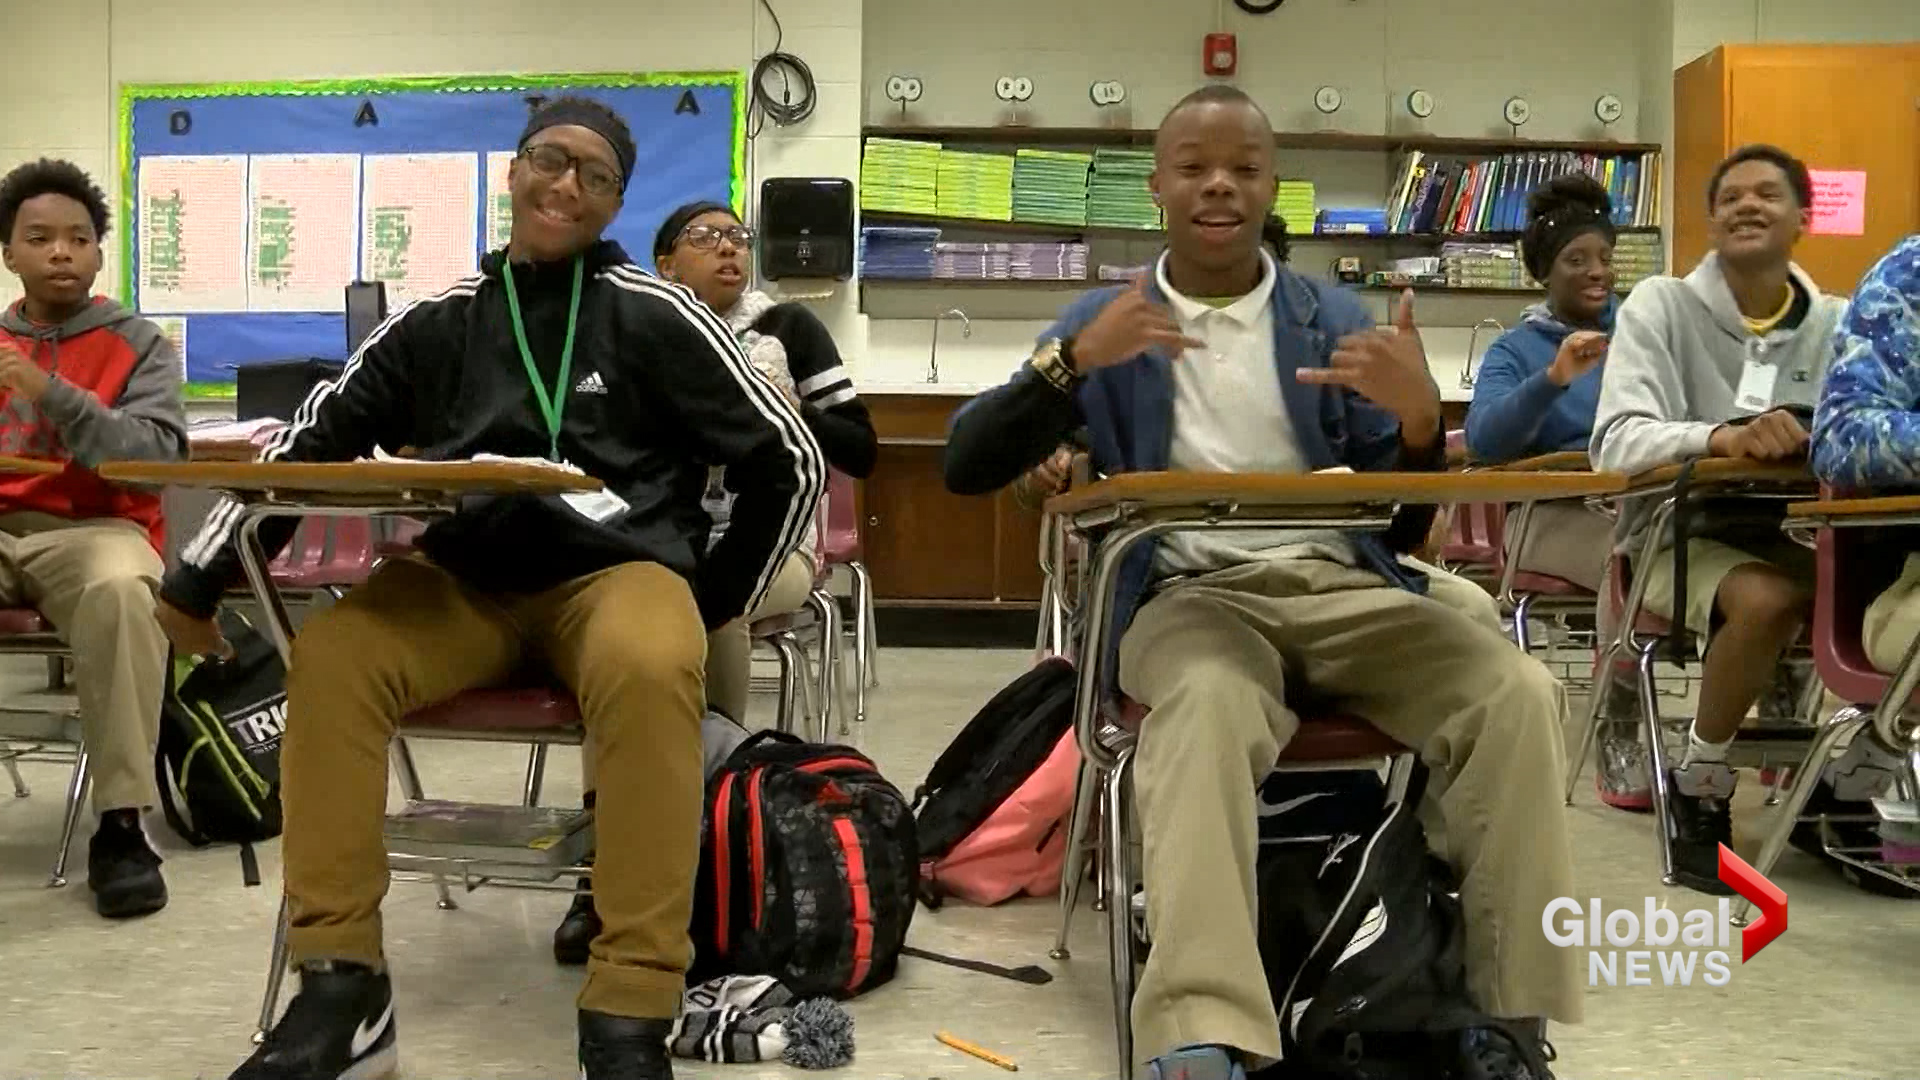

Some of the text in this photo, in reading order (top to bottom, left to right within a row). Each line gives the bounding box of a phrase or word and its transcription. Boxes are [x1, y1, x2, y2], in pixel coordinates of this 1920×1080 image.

[169, 110, 193, 136] D
[354, 99, 379, 128] A
[674, 89, 700, 116] A
